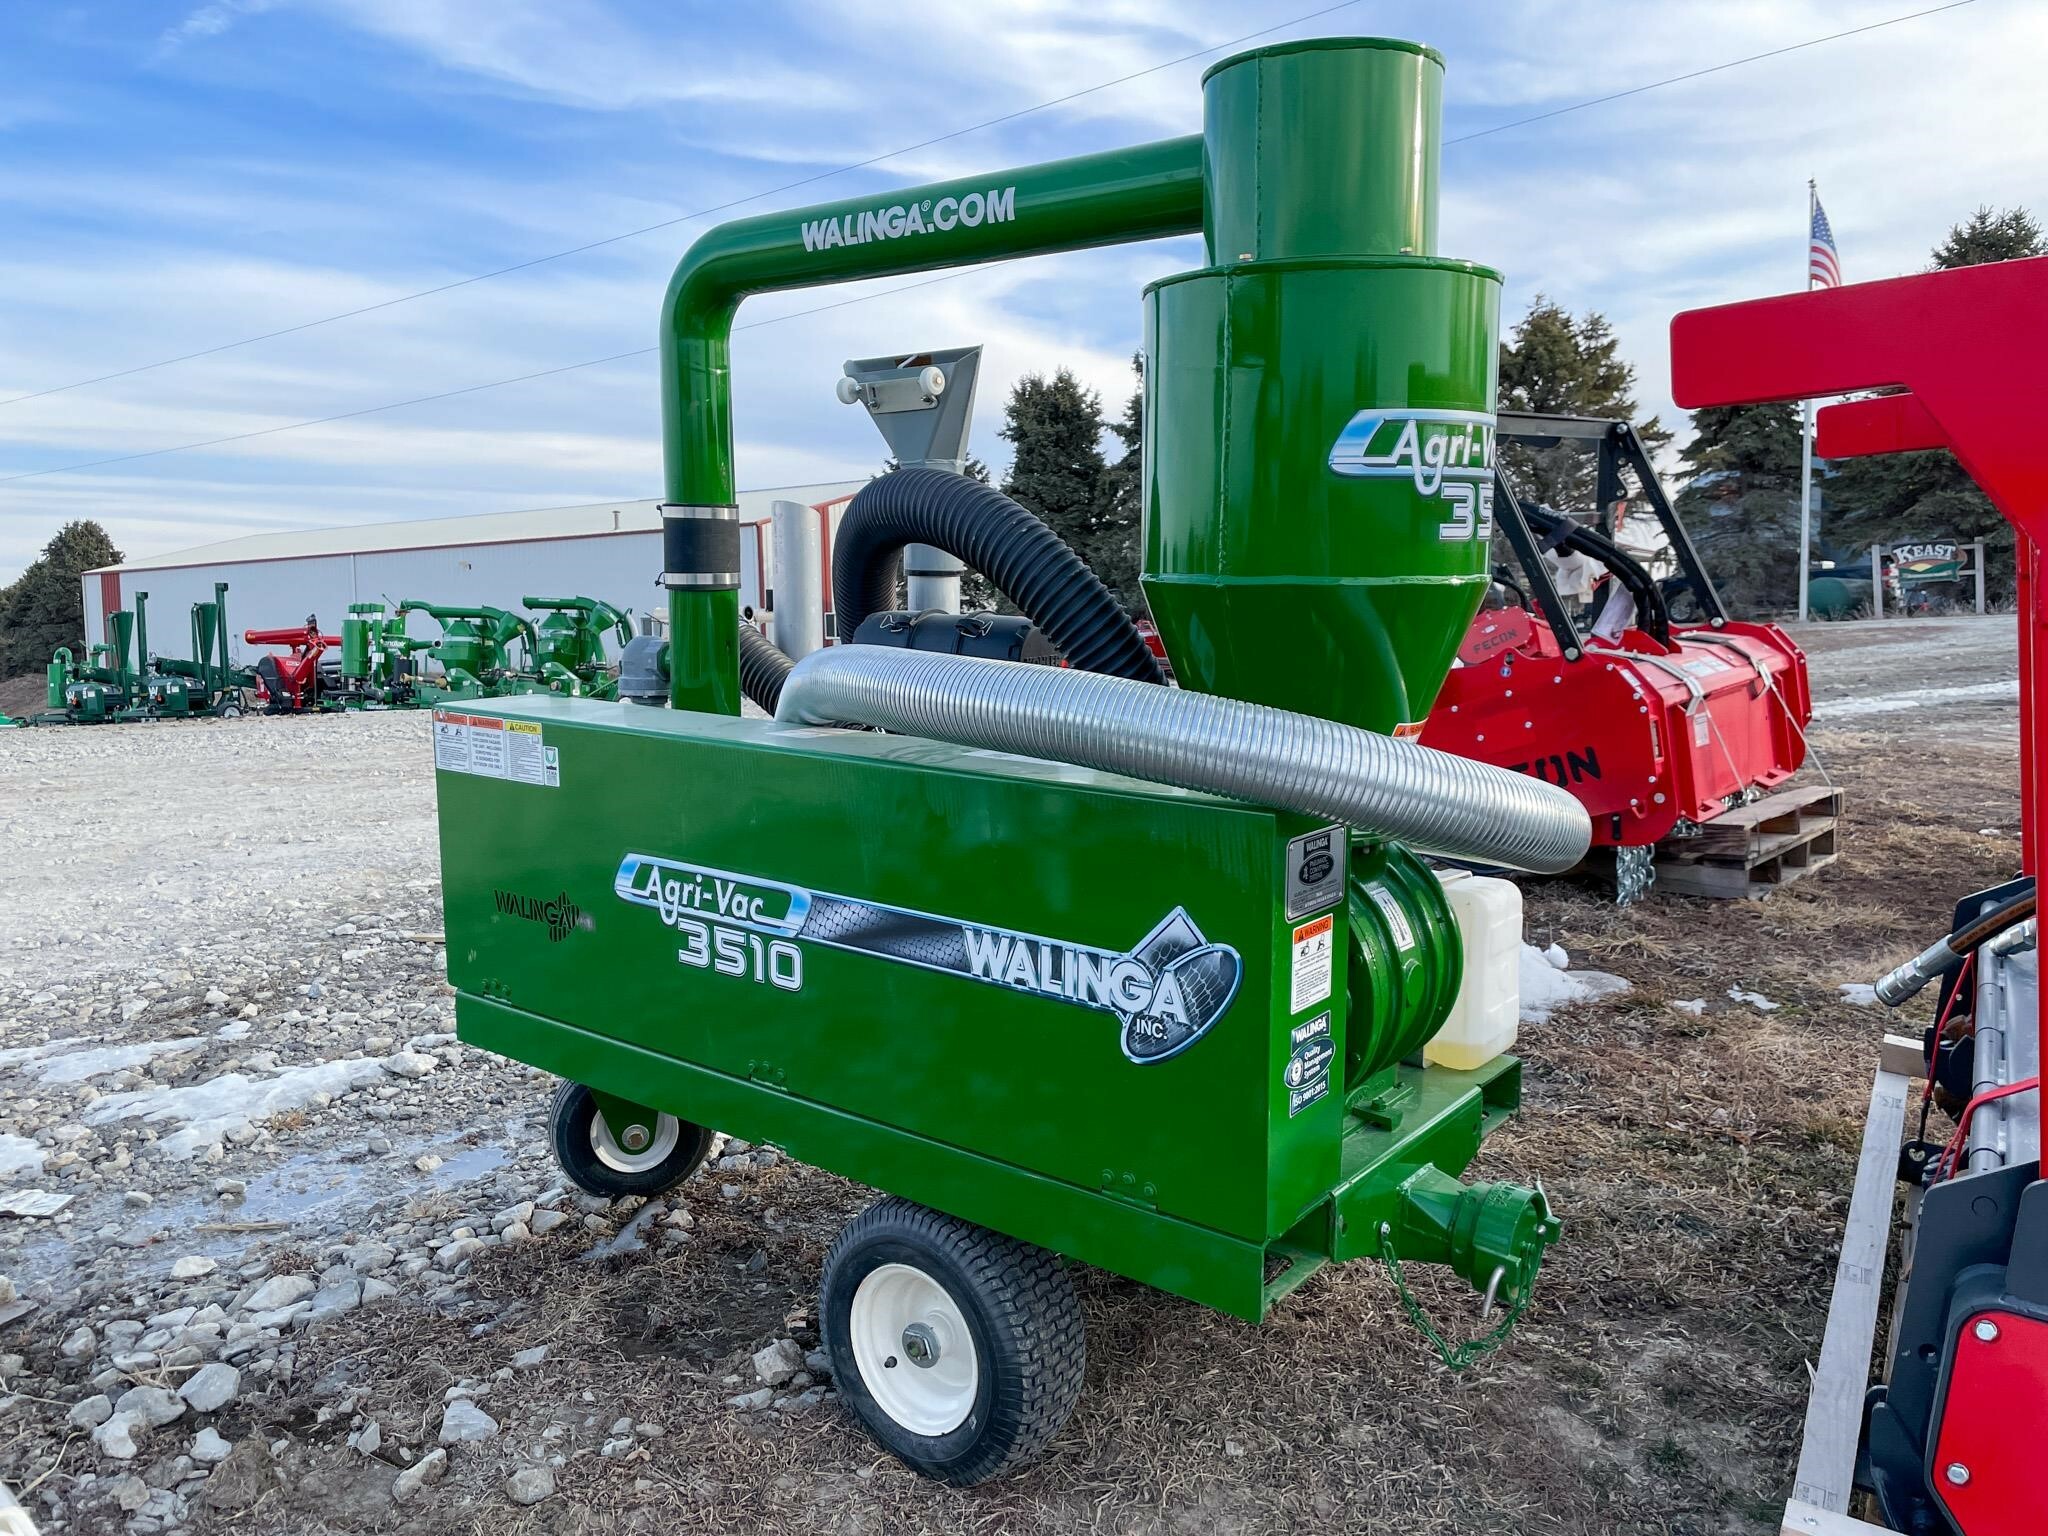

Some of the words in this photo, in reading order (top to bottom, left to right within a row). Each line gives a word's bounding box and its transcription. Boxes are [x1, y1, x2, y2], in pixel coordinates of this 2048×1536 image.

[1893, 544, 1956, 565] KEAST
[1473, 629, 1517, 653] FECON
[514, 723, 537, 733] CAUTION
[648, 865, 764, 925] Agri-Vac
[494, 889, 573, 930] WALINGA
[1304, 920, 1329, 937] WARNING
[677, 917, 803, 992] 3510
[962, 925, 1190, 1028] WALINGA
[1136, 1018, 1168, 1041] INC.
[1304, 1045, 1320, 1060] Quality
[1304, 1047, 1333, 1070] Management
[1304, 1064, 1320, 1079] System
[1293, 1095, 1303, 1107] ISO
[1303, 1080, 1326, 1101] 9001:2015
